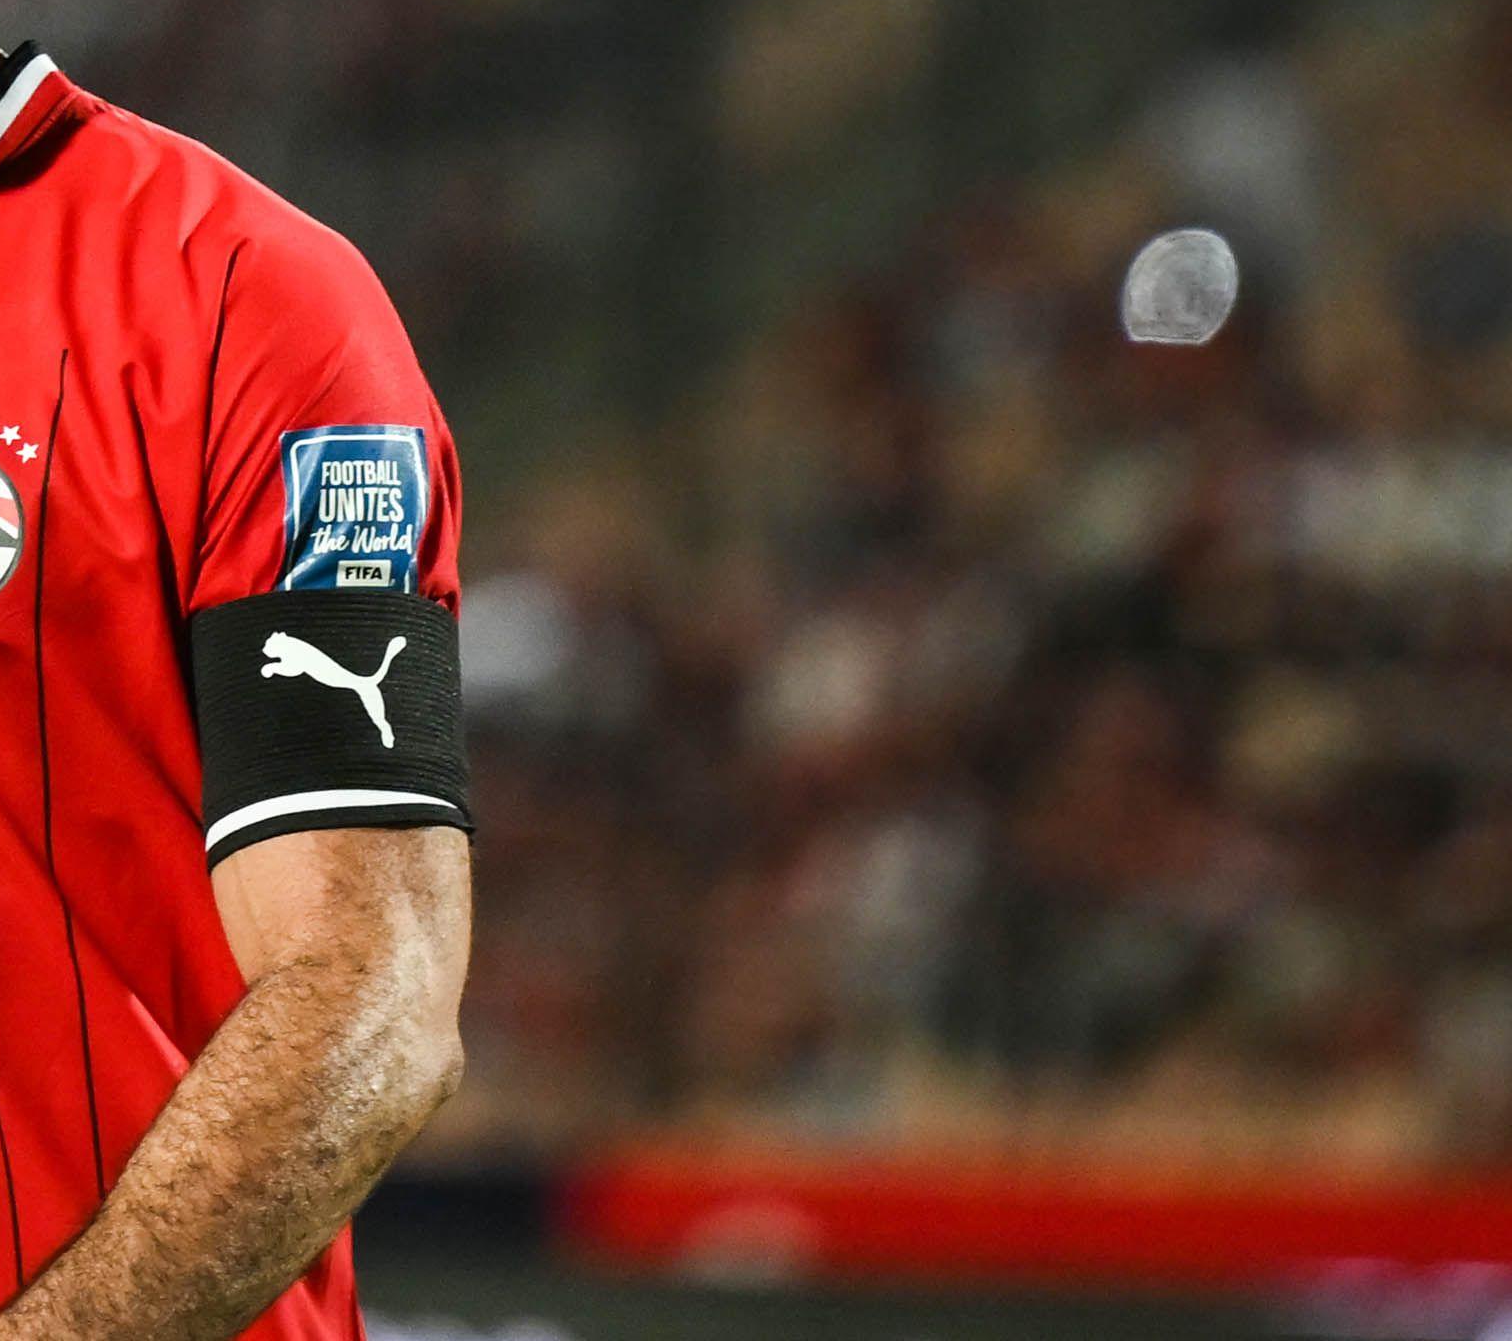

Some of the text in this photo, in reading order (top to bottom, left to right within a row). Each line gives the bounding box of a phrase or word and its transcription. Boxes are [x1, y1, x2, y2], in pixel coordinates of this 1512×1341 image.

[321, 460, 402, 486] FOOTBALL
[318, 488, 405, 523] UNITES
[310, 524, 414, 555] the World
[344, 565, 383, 581] FIFA
